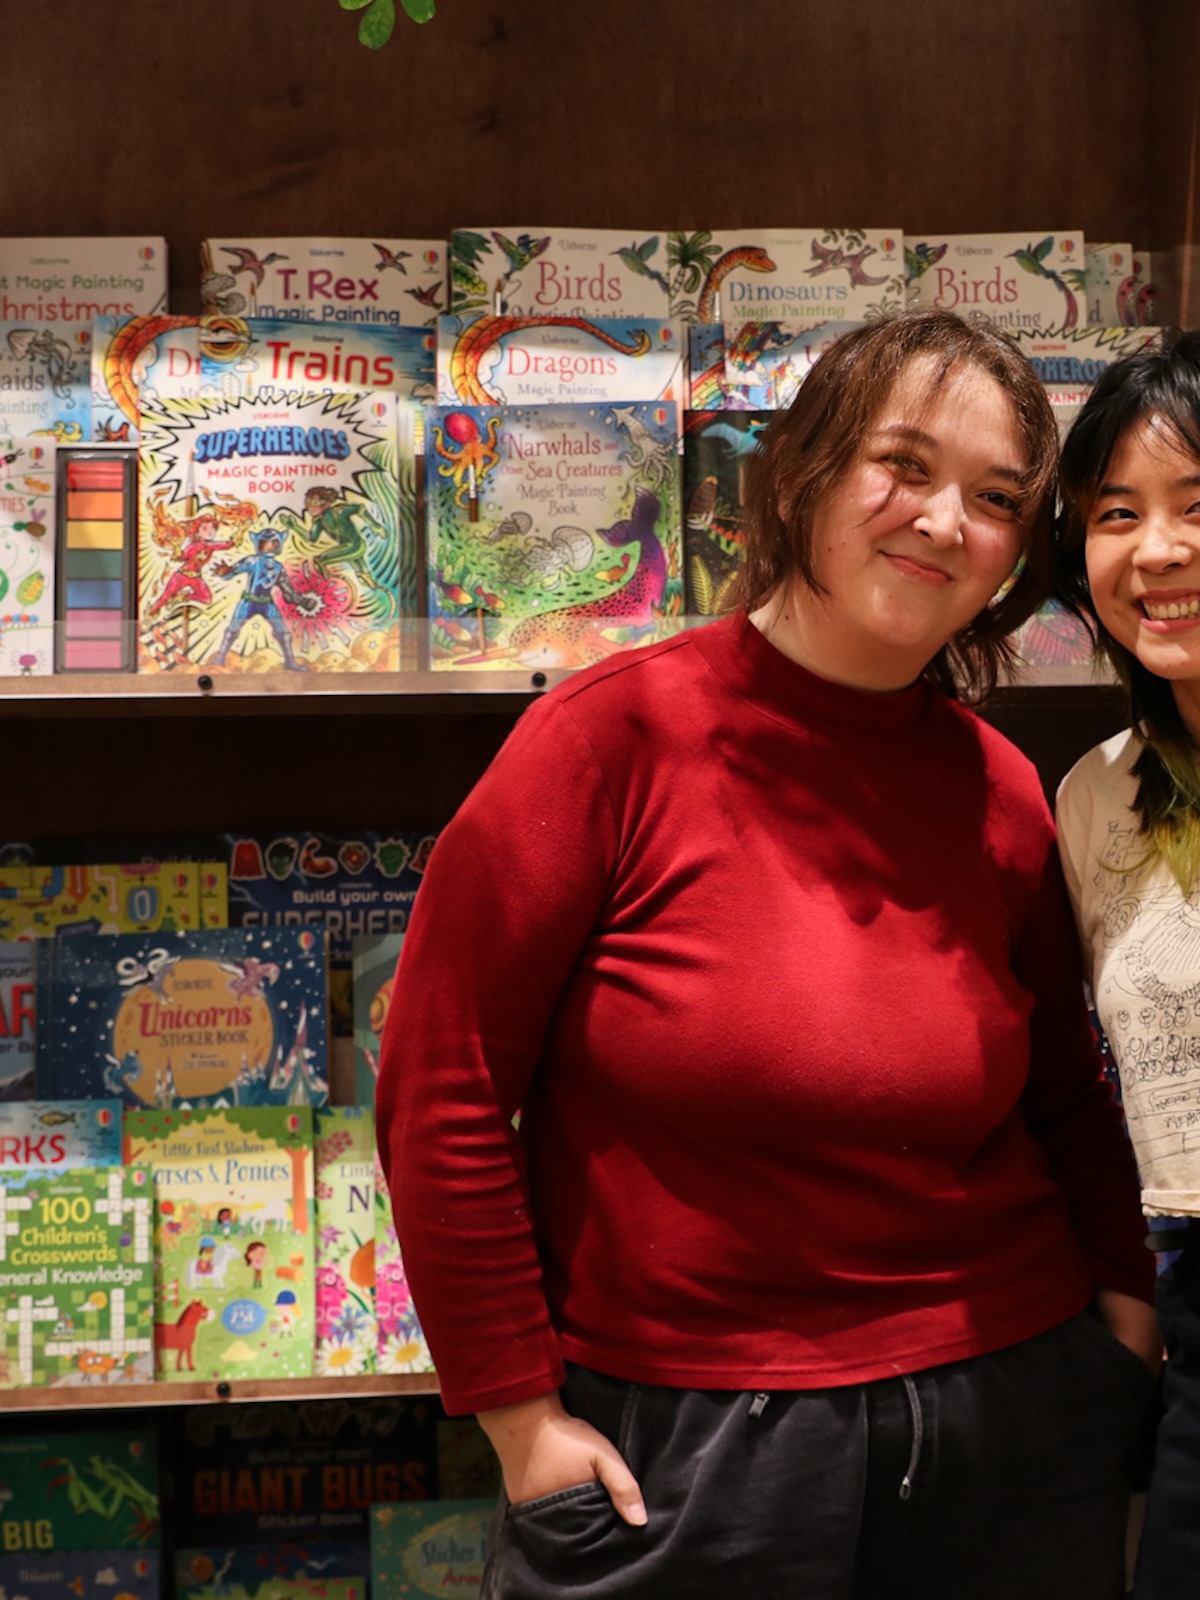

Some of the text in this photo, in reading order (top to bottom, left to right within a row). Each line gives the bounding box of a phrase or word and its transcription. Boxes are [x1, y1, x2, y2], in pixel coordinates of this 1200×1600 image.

[16, 276, 65, 292] Magic
[72, 275, 144, 292] Painting
[535, 260, 623, 306] Birds
[729, 281, 848, 302] Dinosaurs
[933, 266, 1019, 310] Birds
[322, 305, 401, 326] Painting
[732, 304, 846, 320] Magic Painting
[265, 341, 395, 387] Trains
[505, 346, 618, 383] Dragons
[517, 383, 609, 398] Magic Painting
[193, 425, 352, 464] SUPERHEROES
[500, 431, 602, 461] Narwhals
[207, 463, 338, 479] MAGIC PAINTING
[525, 461, 553, 482] Sea
[556, 460, 624, 482] Creatures
[248, 481, 296, 494] BOOK
[516, 484, 607, 502] Magic Painting
[548, 500, 580, 517] Book
[292, 889, 337, 905] Build
[339, 890, 379, 907] your
[137, 1002, 252, 1037] Unicorns
[160, 1030, 248, 1048] STICKER BOOK
[162, 1139, 266, 1158] Little First Stickers
[224, 1158, 291, 1186] Ponies
[39, 1196, 92, 1224] 100
[20, 1224, 108, 1247] Children's
[10, 1242, 119, 1266] Crosswords
[51, 1263, 144, 1287] Knowledge
[191, 1459, 429, 1518] GIANT BUGS
[256, 1511, 365, 1530] Sticker Book
[2, 1518, 55, 1552] BIG
